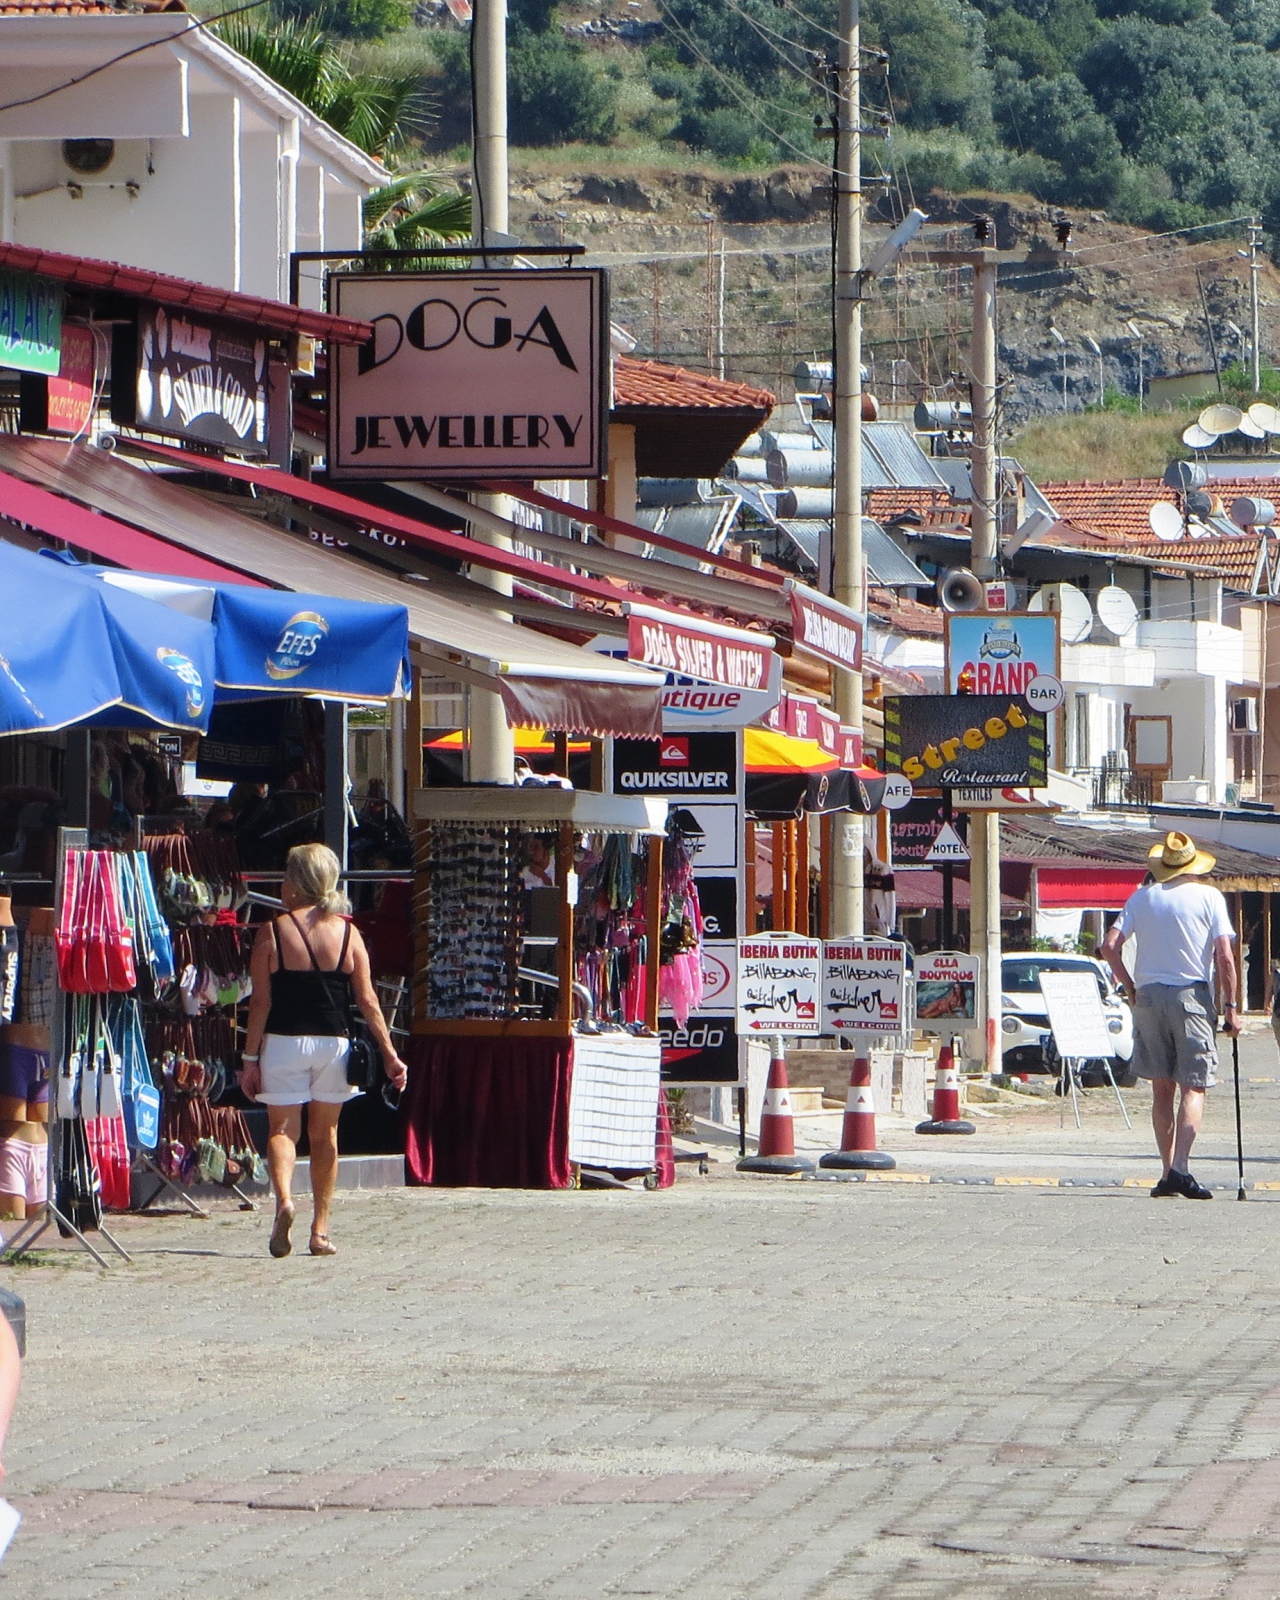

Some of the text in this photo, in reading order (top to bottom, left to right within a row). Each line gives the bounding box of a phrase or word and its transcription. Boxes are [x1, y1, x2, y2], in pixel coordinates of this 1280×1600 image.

[222, 372, 255, 439] GOLD
[351, 414, 583, 455] JEWELLERY
[277, 630, 322, 658] EFES
[674, 634, 714, 679] SILVER
[716, 644, 725, 682] &
[726, 647, 763, 688] WATCH
[961, 661, 1039, 695] GRAND
[662, 688, 741, 711] utique
[1030, 688, 1057, 700] BAR
[902, 703, 1029, 781] street
[620, 771, 729, 788] QUIKSILVER
[939, 768, 1028, 785] Restaurant
[886, 786, 911, 797] AFE
[958, 788, 993, 801] TEXTILES
[932, 844, 965, 854] HOTEL
[661, 1023, 725, 1048] eedo
[759, 1021, 819, 1030] WELCOME
